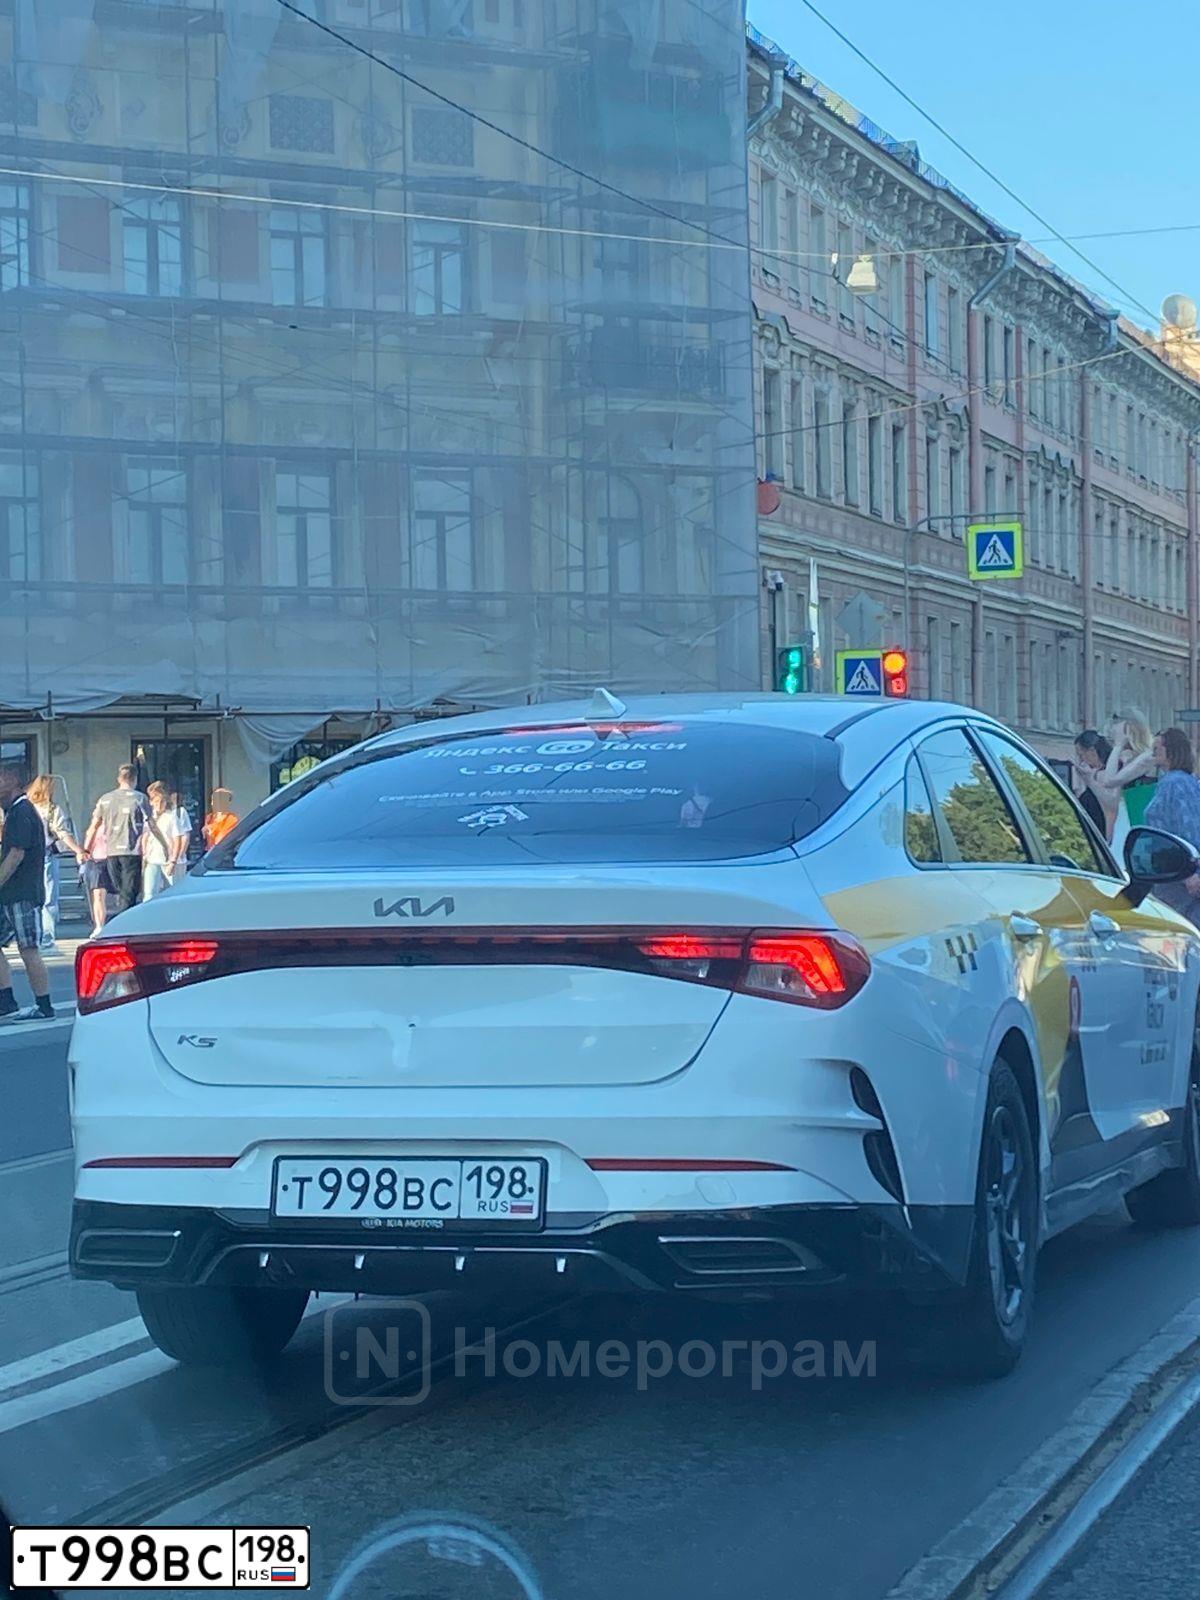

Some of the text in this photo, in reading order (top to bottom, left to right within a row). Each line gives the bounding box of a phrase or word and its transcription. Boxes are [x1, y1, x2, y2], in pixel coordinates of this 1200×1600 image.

[424, 746, 531, 758] Яндекс
[600, 741, 688, 751] Такси
[484, 760, 647, 774] 366-66-66
[591, 787, 648, 796] Google
[650, 787, 684, 796] Play
[465, 1165, 527, 1199] 198
[477, 1200, 509, 1213] RUS
[386, 1219, 403, 1228] KIA
[404, 1219, 444, 1229] MOTORS
